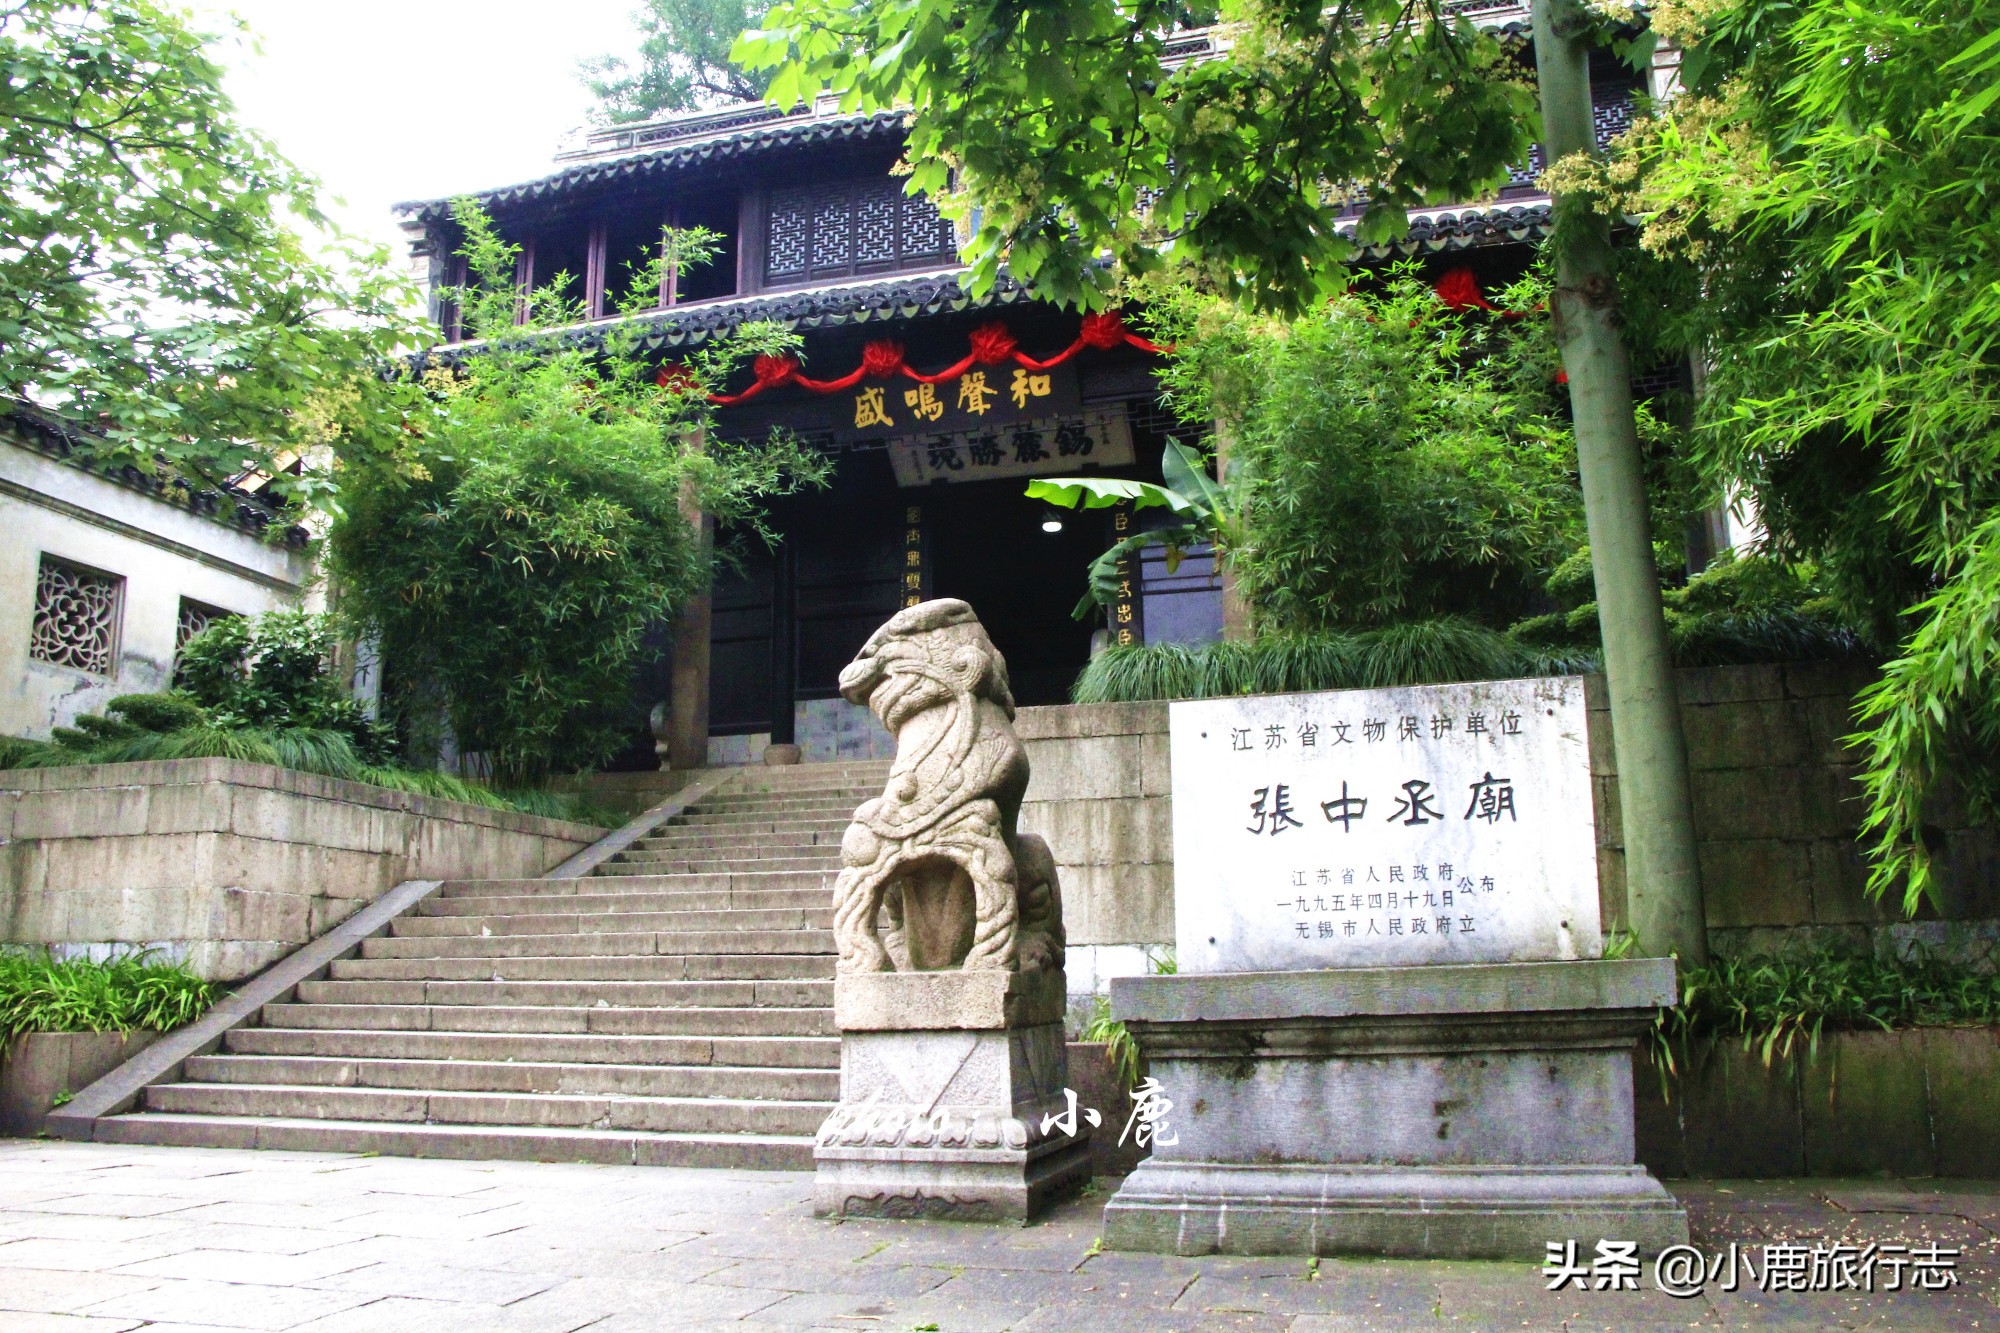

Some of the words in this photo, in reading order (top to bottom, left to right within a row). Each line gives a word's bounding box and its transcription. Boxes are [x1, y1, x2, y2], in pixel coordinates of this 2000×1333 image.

[1231, 709, 1524, 752] 江苏省文物保护单位
[1246, 771, 1518, 837] 張中丞廟
[1291, 861, 1454, 887] 江苏省人民政府
[1457, 875, 1495, 895] 公布
[1276, 889, 1455, 914] 一九九五年四月十九日
[1294, 914, 1476, 940] 无锡市人民政府立
